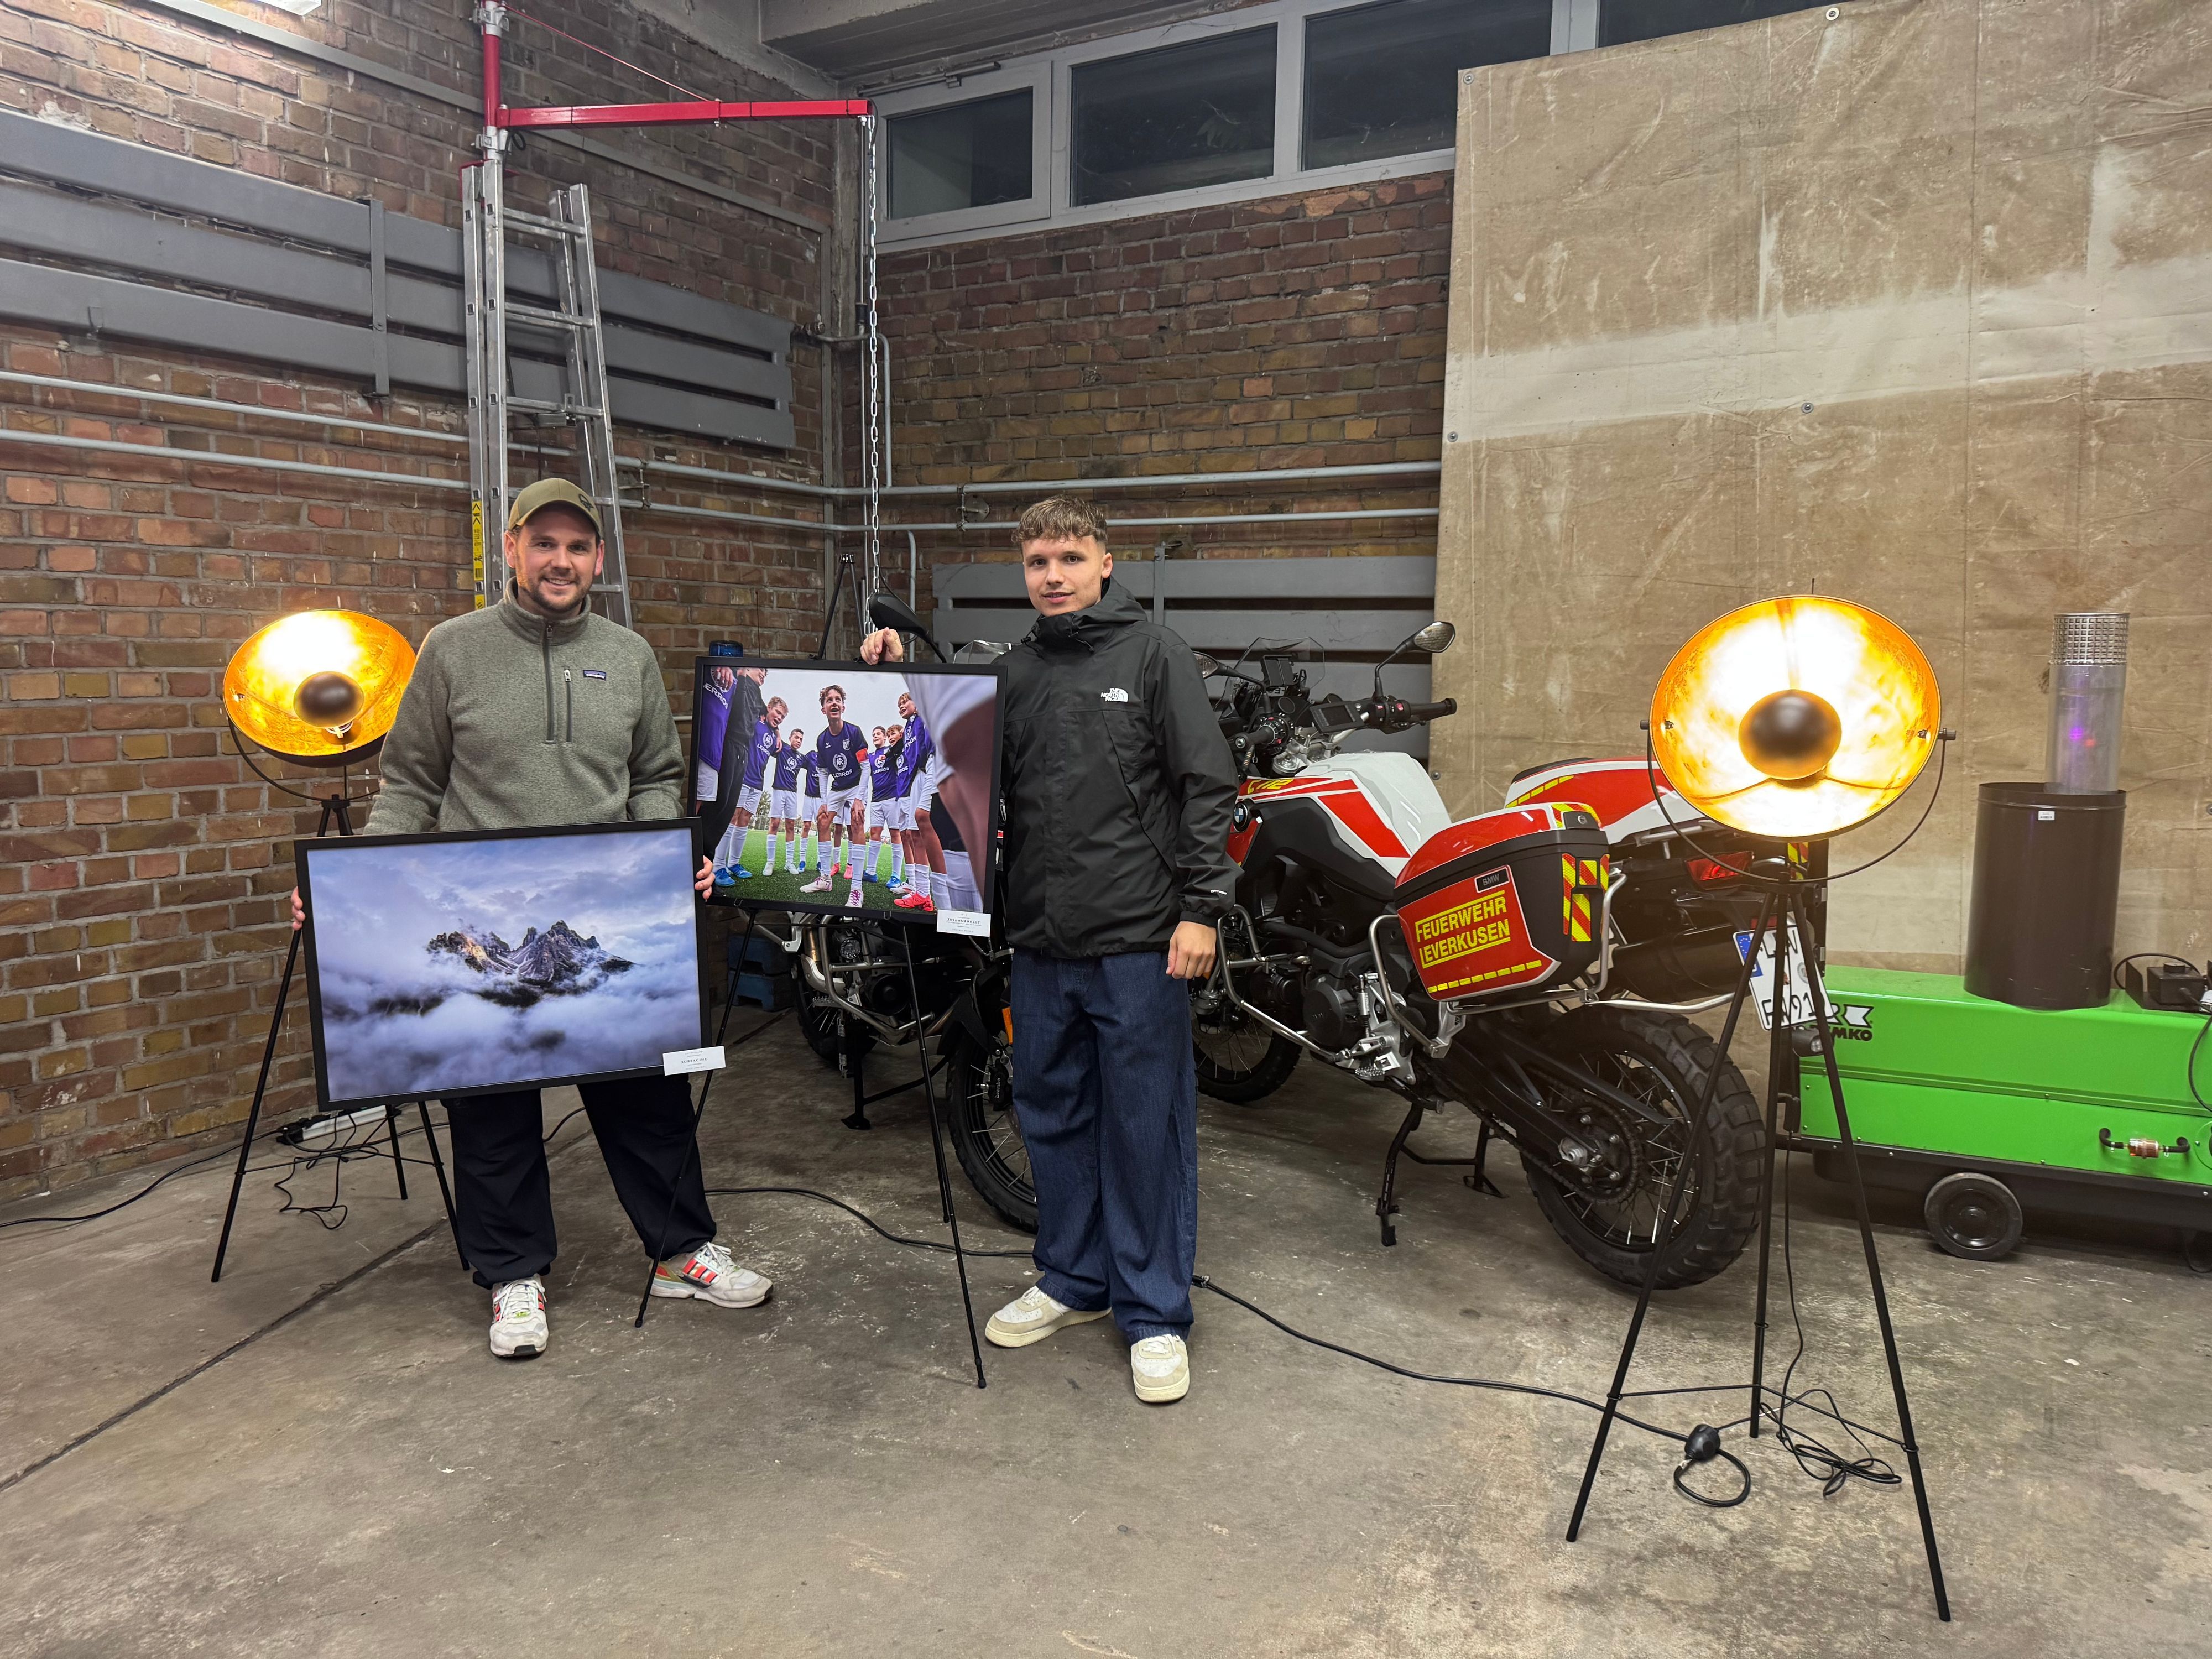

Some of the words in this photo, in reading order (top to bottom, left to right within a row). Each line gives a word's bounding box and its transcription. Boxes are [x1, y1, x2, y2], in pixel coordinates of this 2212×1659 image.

[703, 682, 728, 710] ERROS
[833, 769, 853, 778] LERROS
[1482, 873, 1500, 886] BMW
[1415, 890, 1507, 942] FEUERWEHR
[1419, 919, 1511, 969] LEVERKUSEN
[1761, 930, 1798, 958] LV
[1810, 1025, 1873, 1041] MKO
